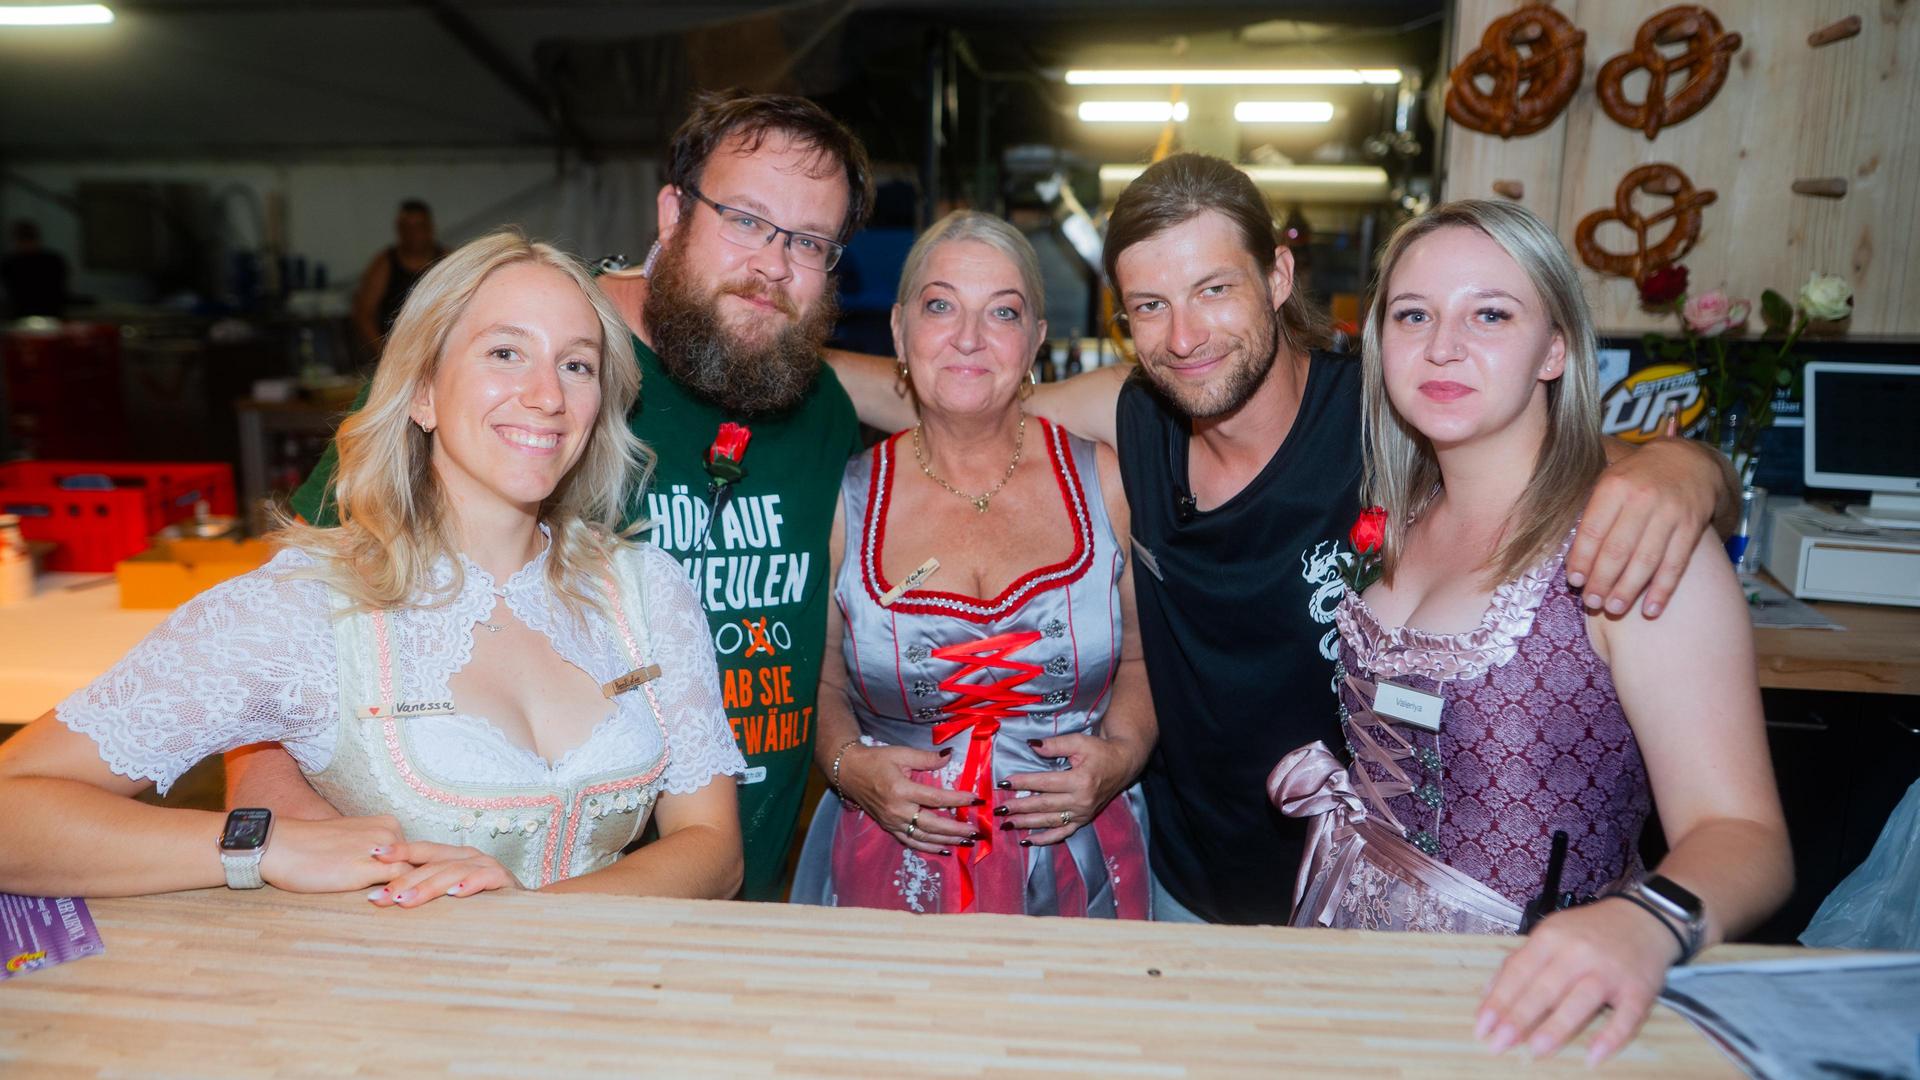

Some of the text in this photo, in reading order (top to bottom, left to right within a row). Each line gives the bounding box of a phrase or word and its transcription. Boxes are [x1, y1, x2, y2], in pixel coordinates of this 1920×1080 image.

[648, 485, 783, 551] HÖR AUF
[396, 702, 455, 713] Vanessa
[722, 666, 795, 709] AB SIE
[728, 706, 813, 755] EWÄHLT
